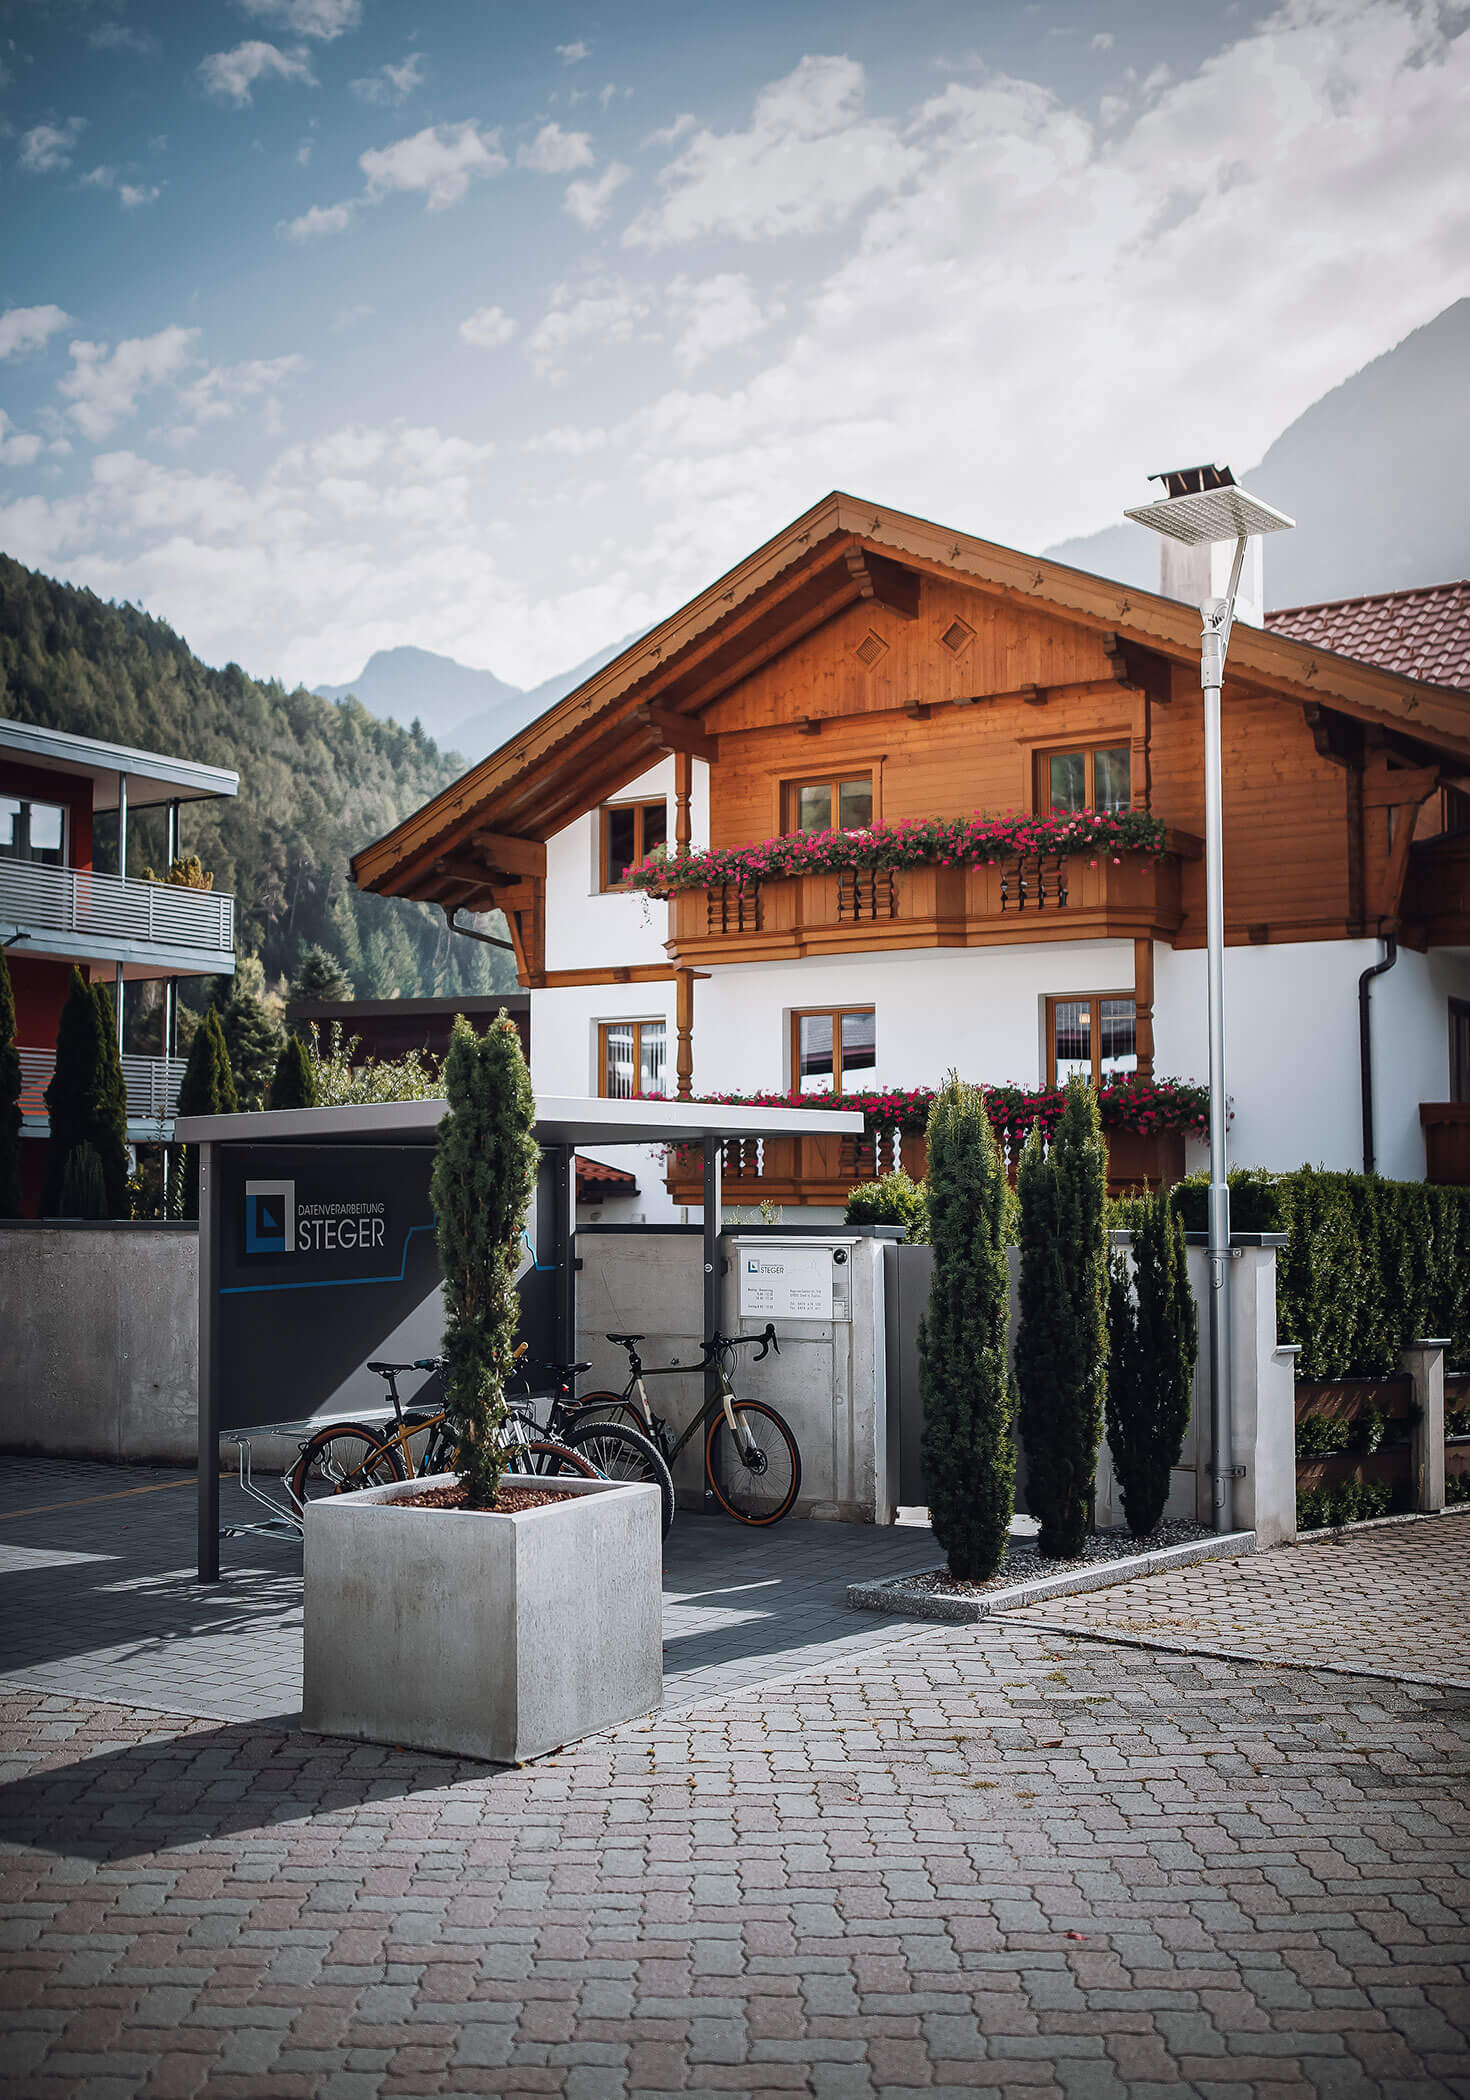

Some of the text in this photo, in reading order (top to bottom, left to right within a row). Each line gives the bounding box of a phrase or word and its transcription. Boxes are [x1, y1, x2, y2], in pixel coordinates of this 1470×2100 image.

[298, 1203, 385, 1215] DATENVERARBEITUNG
[299, 1218, 385, 1251] STEGER
[760, 1266, 785, 1274] STEGER
